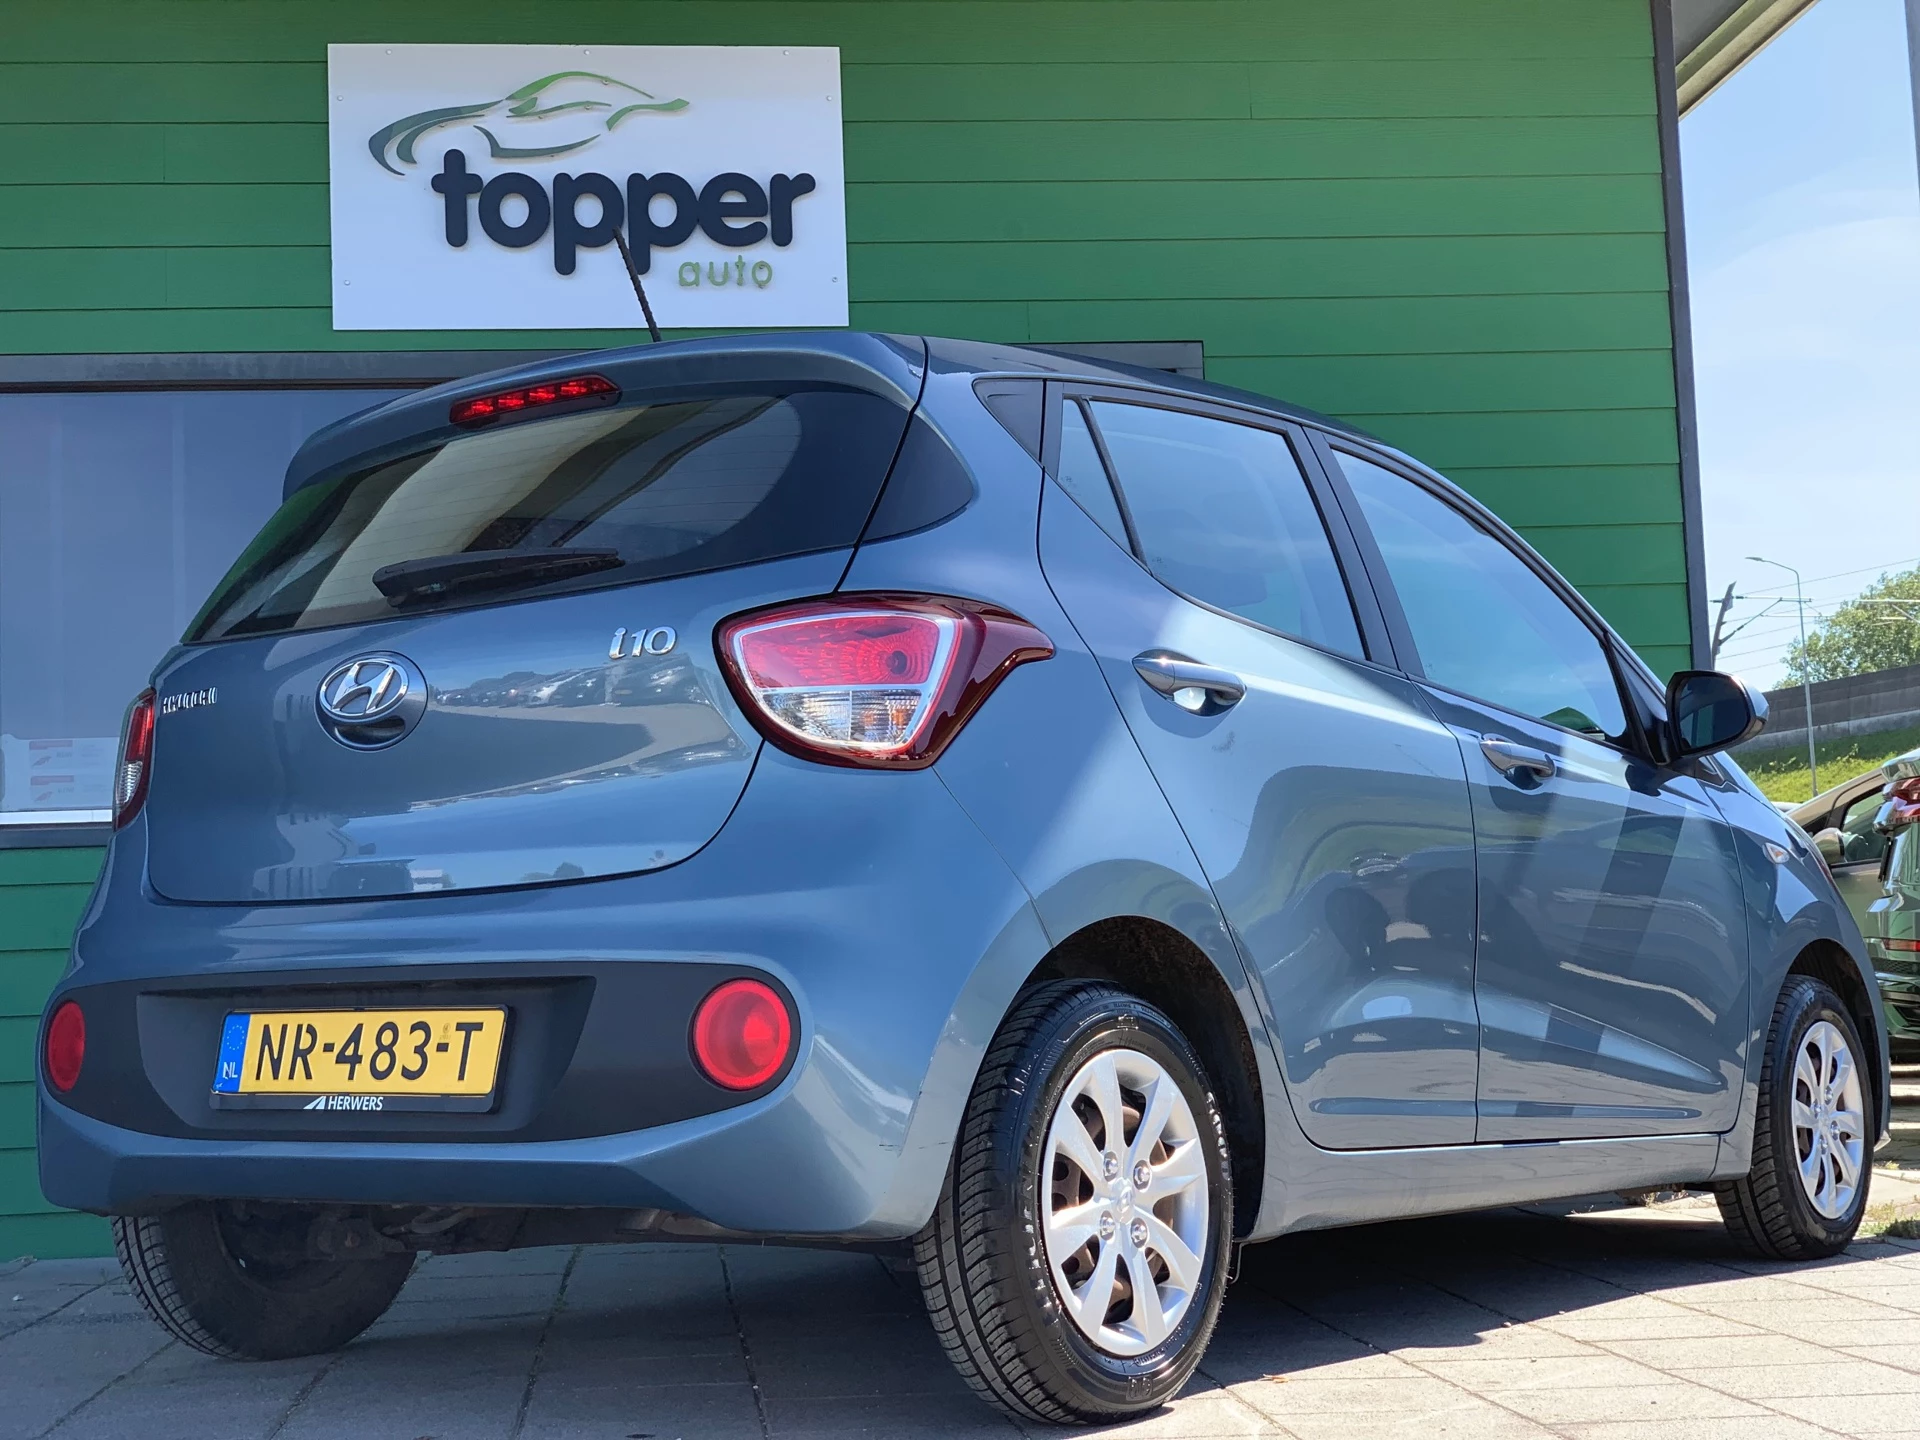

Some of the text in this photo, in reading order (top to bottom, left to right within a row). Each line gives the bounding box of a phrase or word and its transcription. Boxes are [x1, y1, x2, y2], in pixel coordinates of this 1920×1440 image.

[430, 148, 816, 276] topper
[677, 254, 774, 288] auto
[608, 626, 677, 660] i10
[255, 1021, 485, 1082] NR-483-T
[222, 1061, 239, 1079] NL
[327, 1095, 384, 1111] HERWERS
